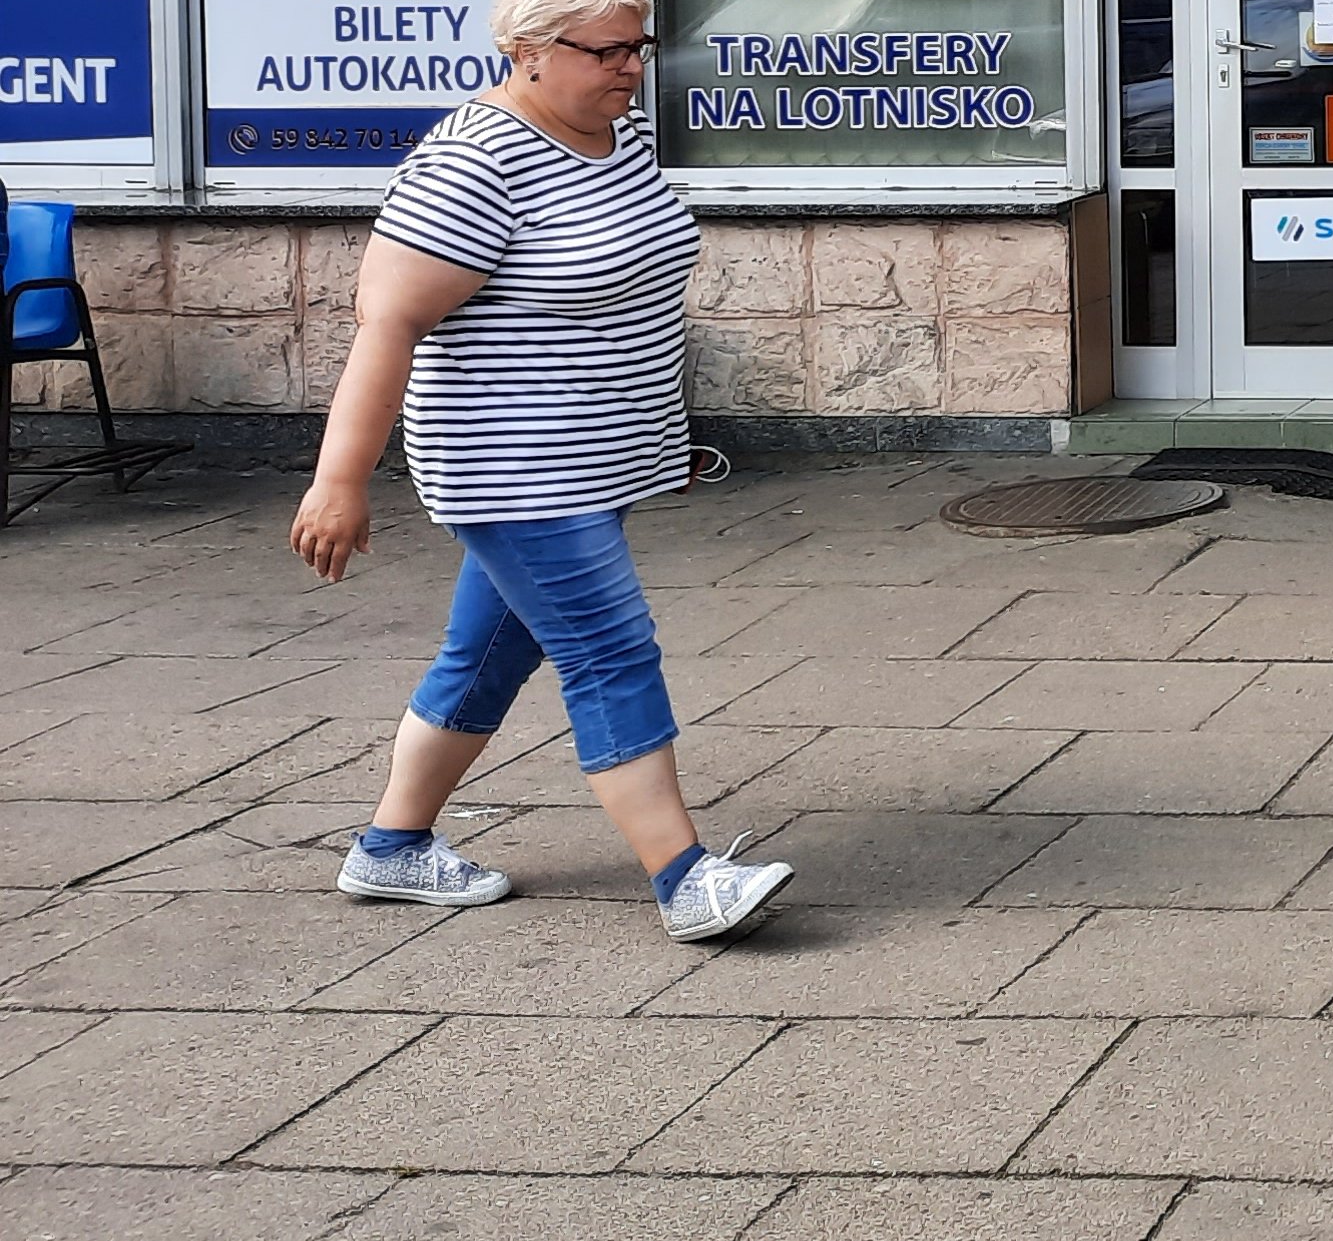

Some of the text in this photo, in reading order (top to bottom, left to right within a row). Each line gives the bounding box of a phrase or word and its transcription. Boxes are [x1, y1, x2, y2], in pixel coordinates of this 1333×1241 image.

[334, 6, 470, 42] BILETY
[708, 32, 1011, 75] TRANSFERY
[257, 55, 512, 92] AUTOKAROW
[688, 86, 1035, 130] NA LOTNISKO
[271, 128, 419, 150] 59 842 70 14
